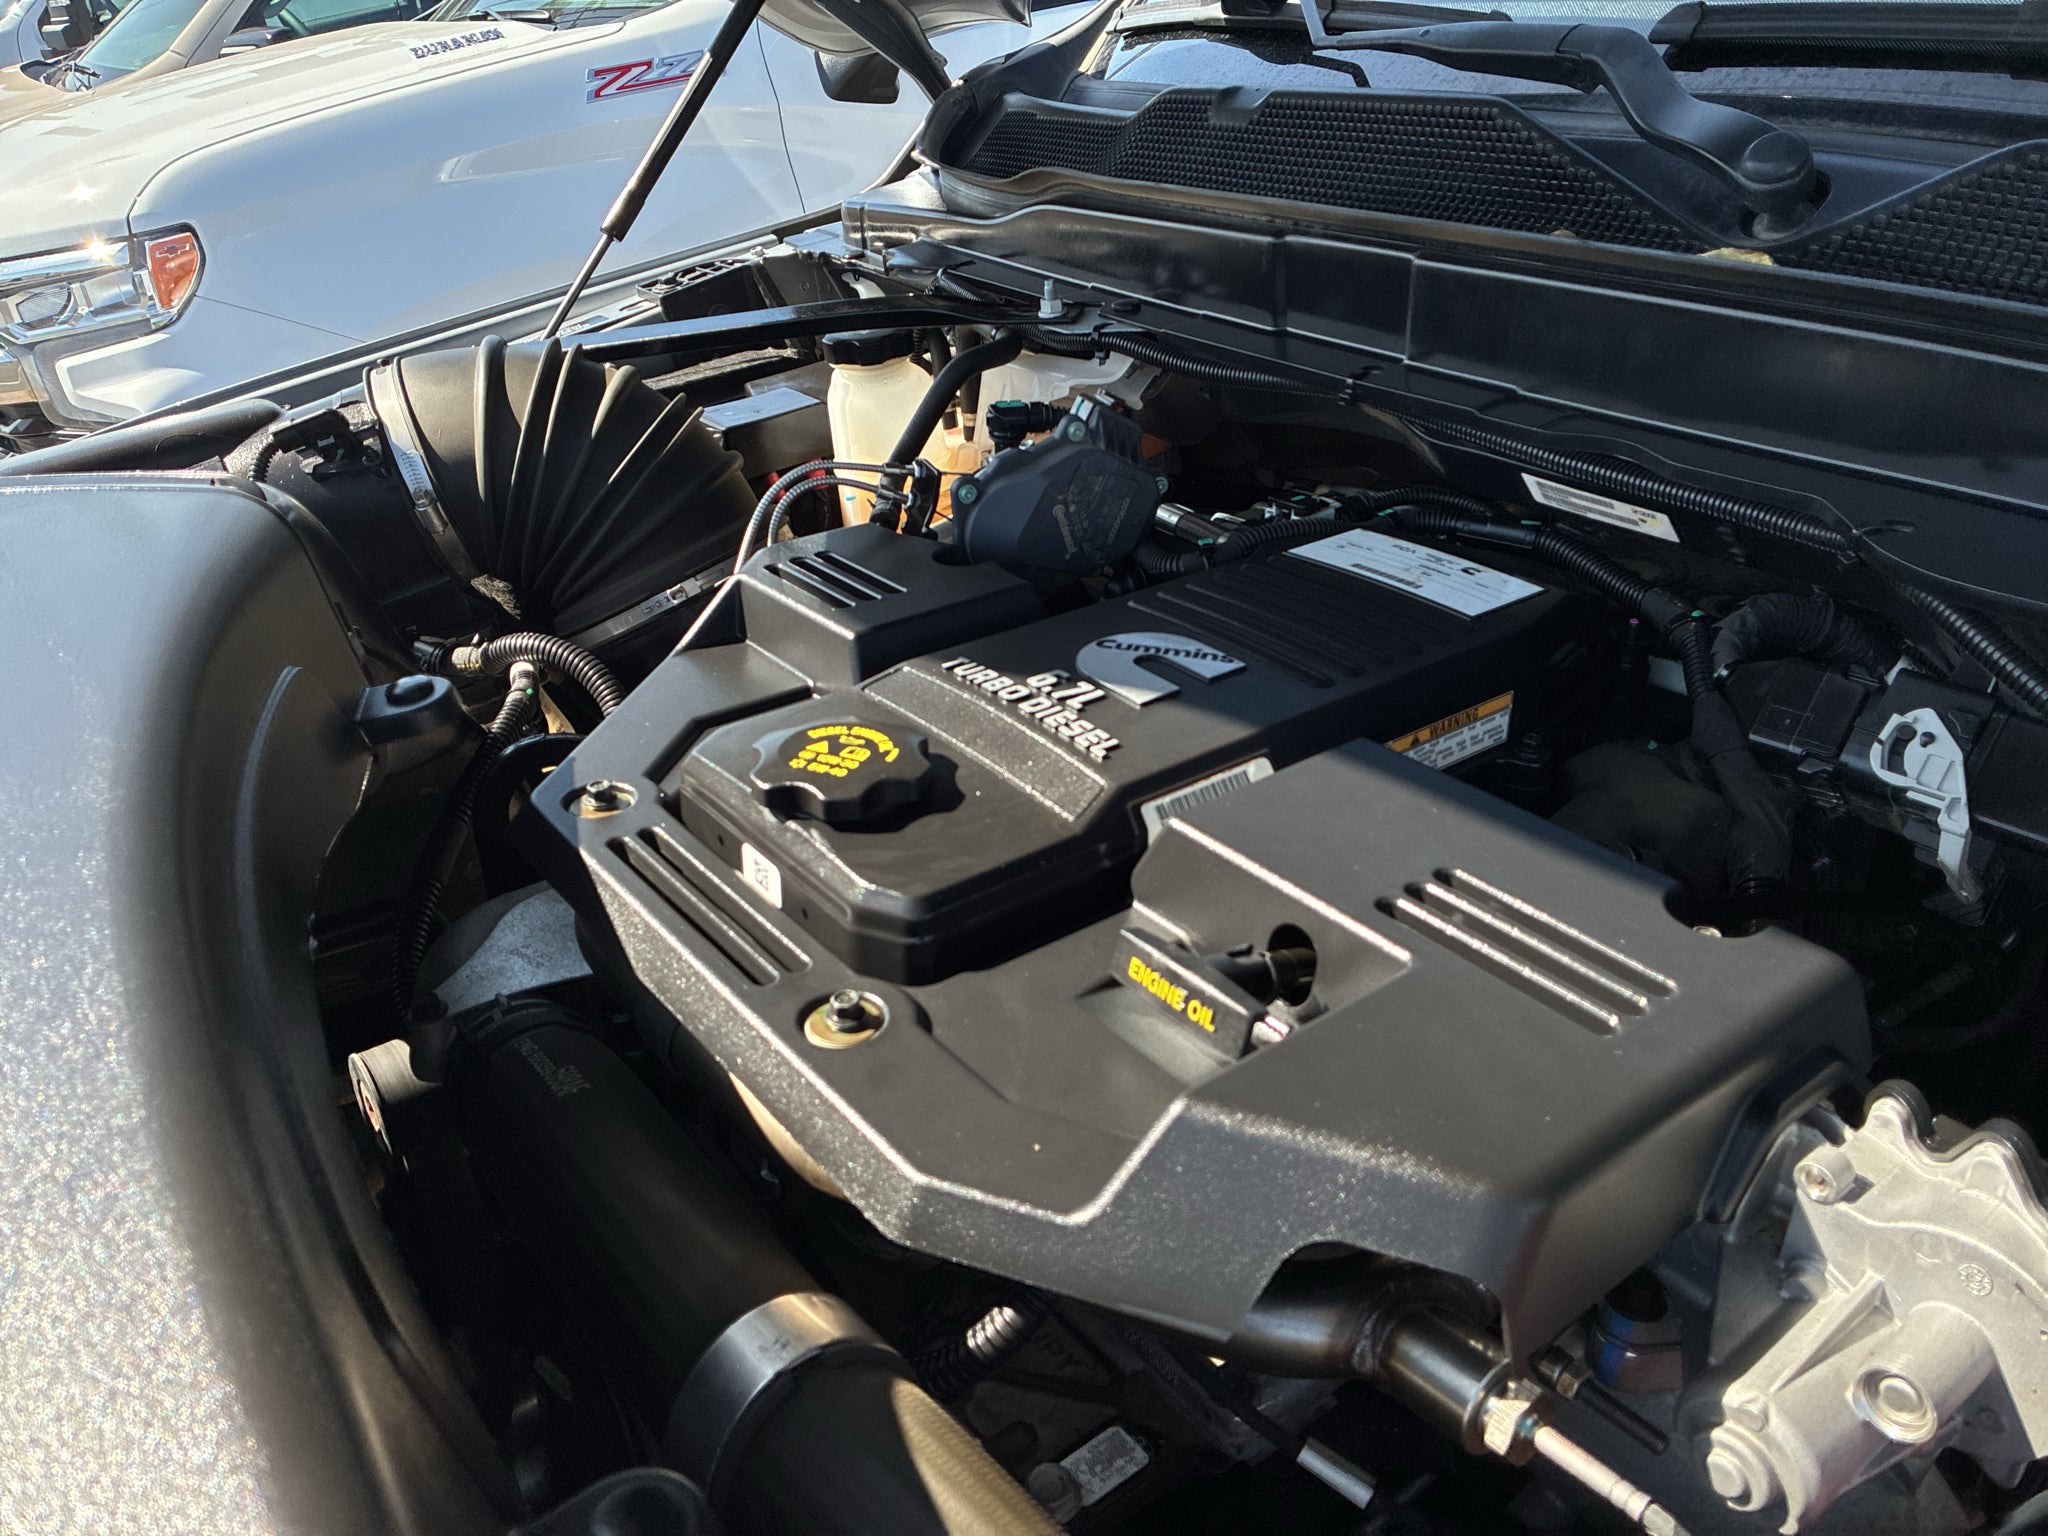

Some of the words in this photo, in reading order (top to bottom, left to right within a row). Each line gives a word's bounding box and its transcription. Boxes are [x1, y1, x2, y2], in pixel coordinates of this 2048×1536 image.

[410, 28, 505, 59] DURAMAX
[586, 49, 704, 103] Z7
[1095, 638, 1239, 664] Cummins
[941, 655, 1031, 704] TURBO
[1017, 692, 1123, 762] DIESEL
[1026, 669, 1107, 710] 6.7L
[1429, 707, 1480, 737] WARNING
[1127, 956, 1188, 1012] ENGINE
[1186, 998, 1216, 1033] OIL
